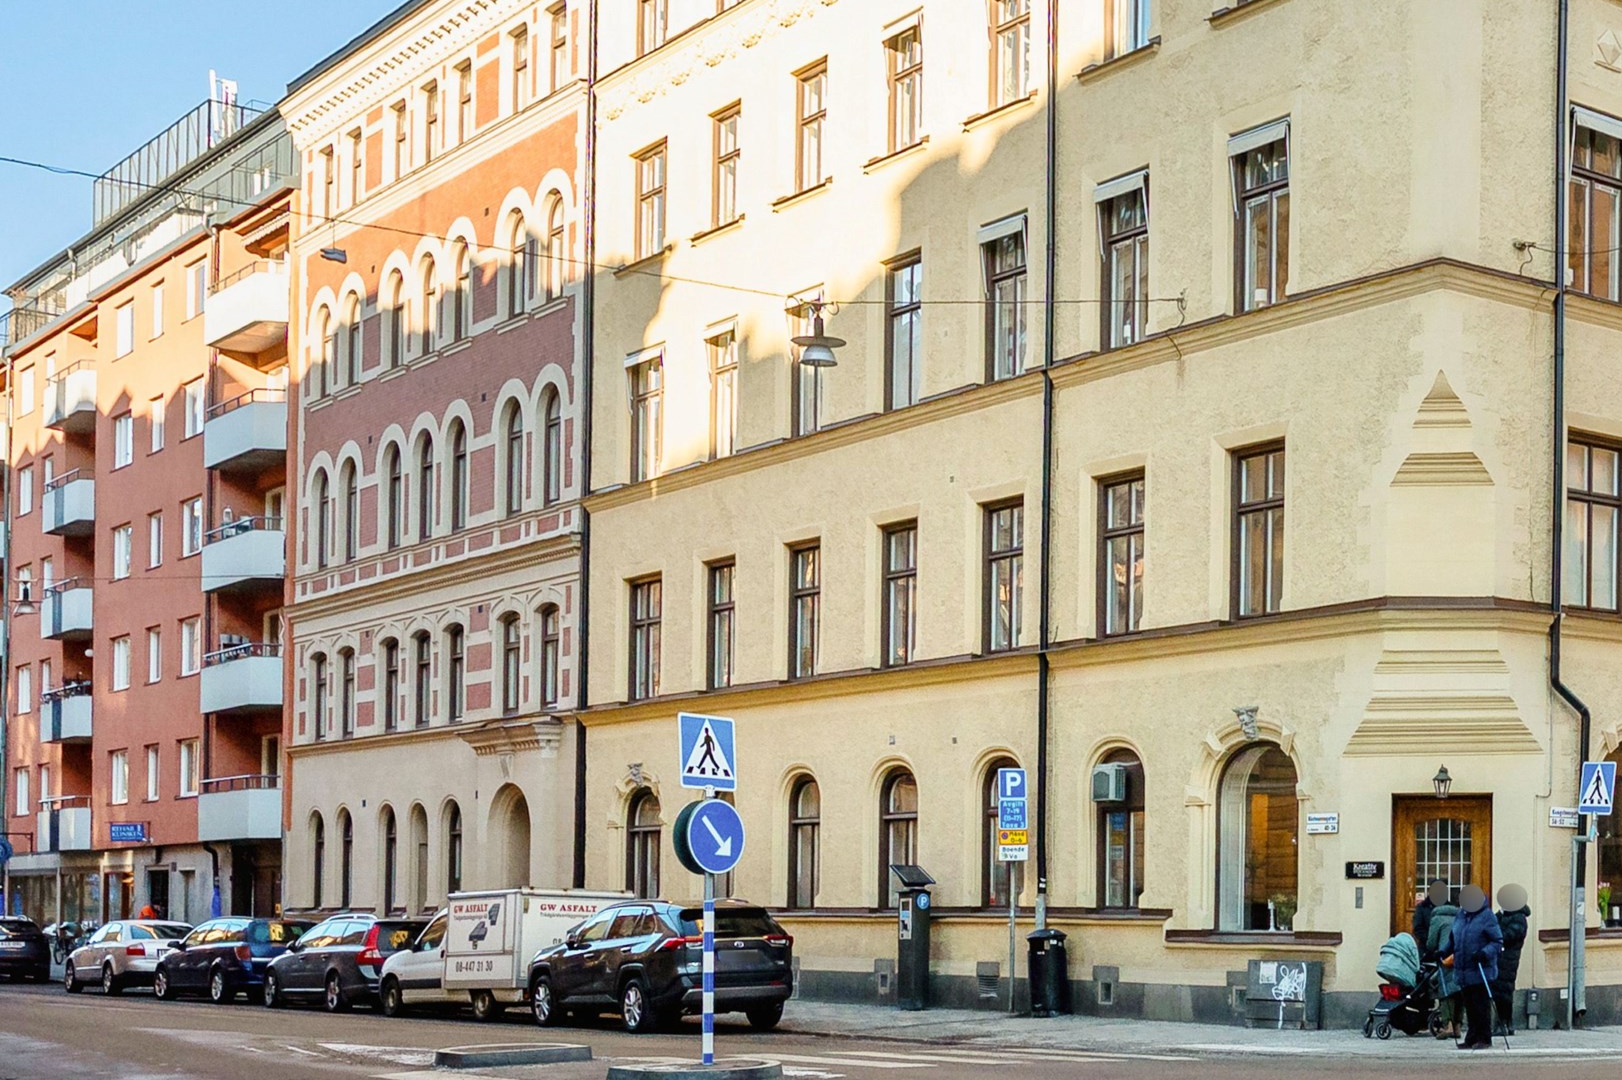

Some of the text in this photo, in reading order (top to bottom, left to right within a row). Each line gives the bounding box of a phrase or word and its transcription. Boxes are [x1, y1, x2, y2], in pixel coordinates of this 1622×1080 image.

[1005, 771, 1022, 796] P
[454, 904, 488, 913] GW ASFALT
[560, 904, 598, 913] ASFALT
[455, 961, 475, 973] 08-447
